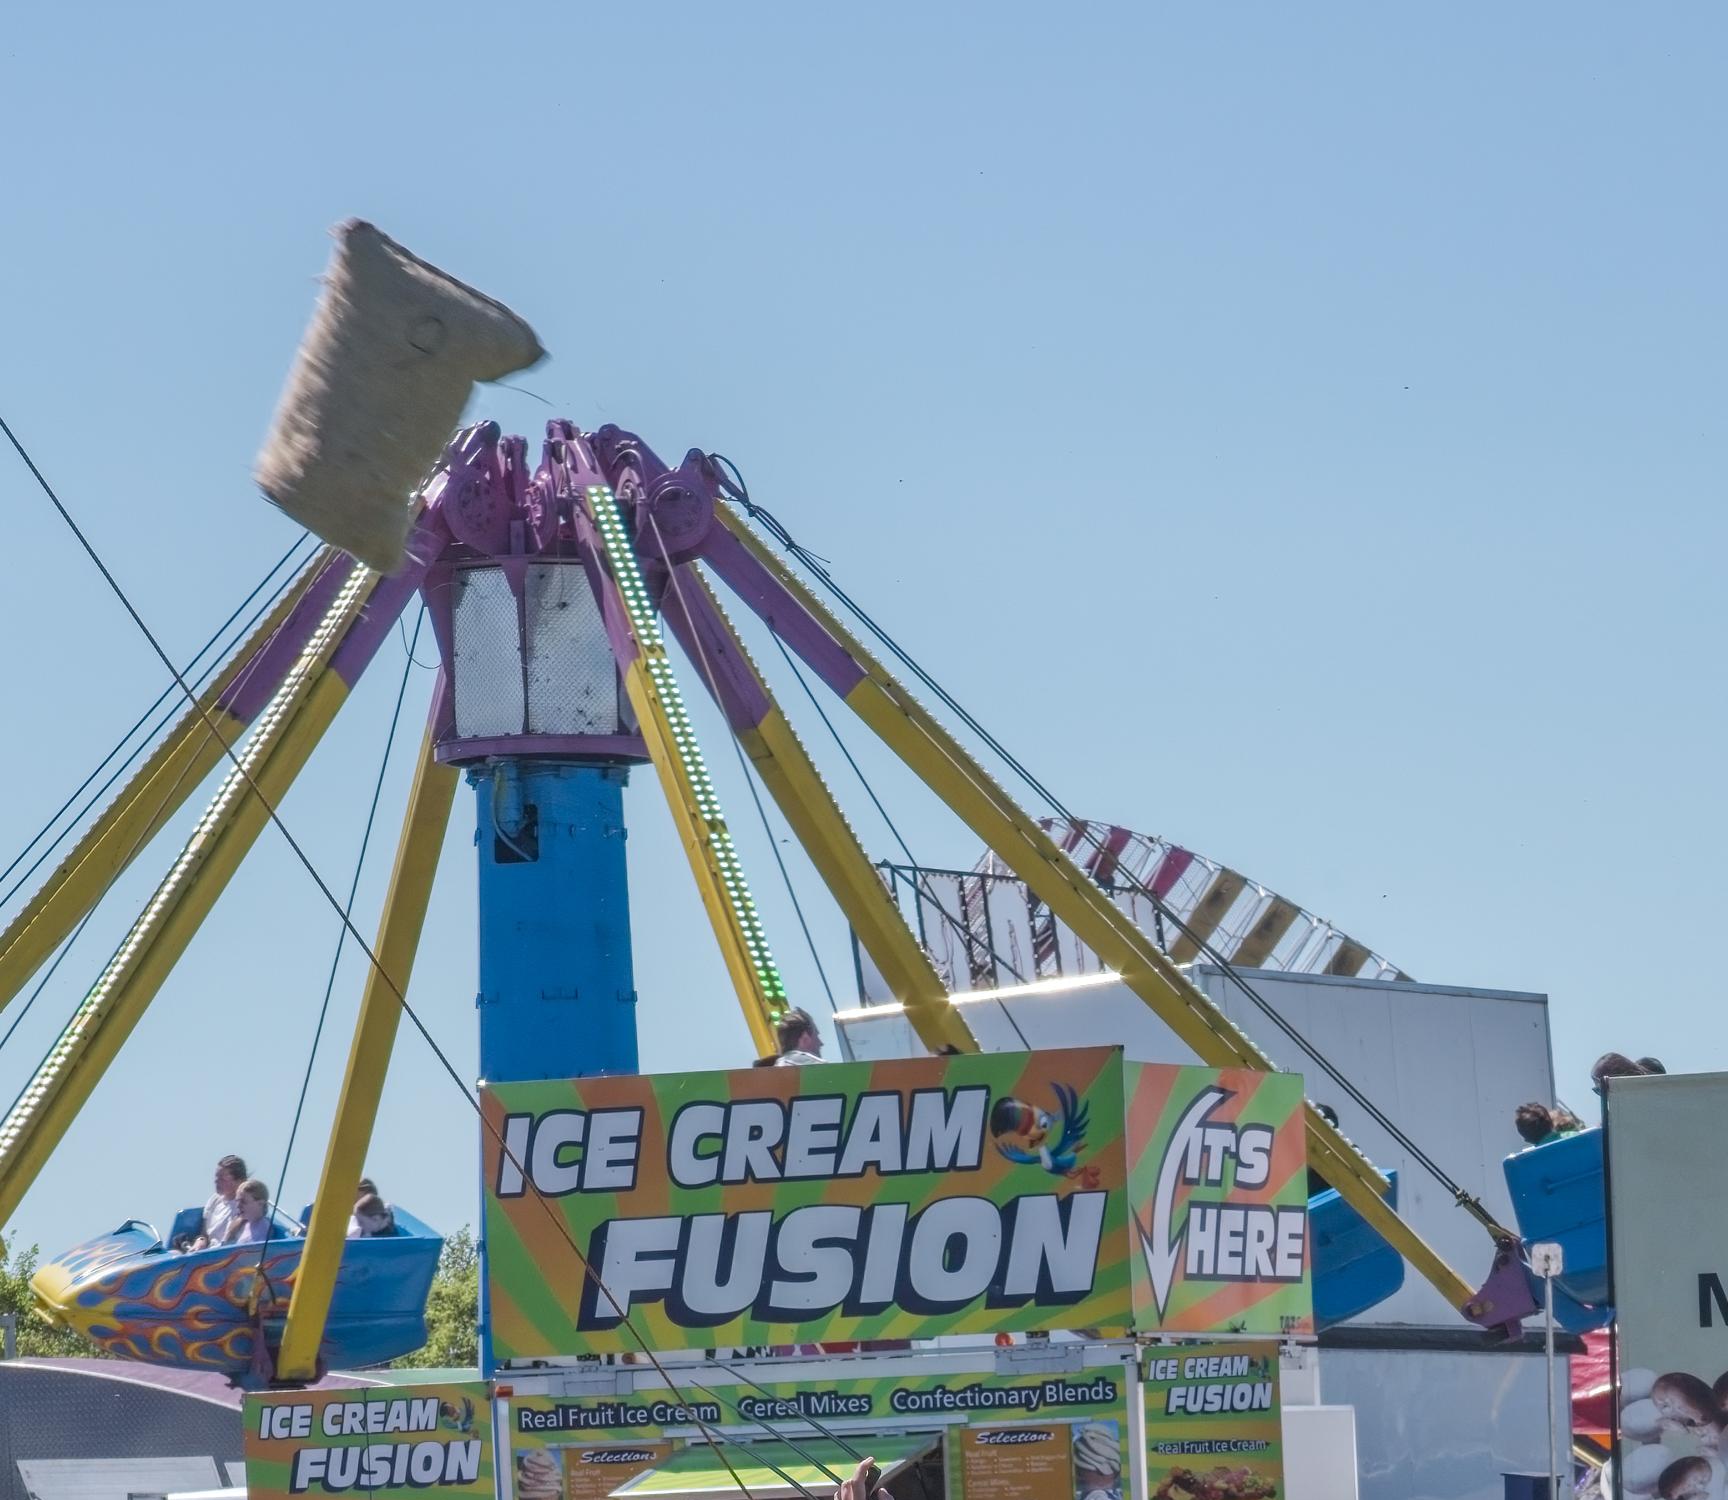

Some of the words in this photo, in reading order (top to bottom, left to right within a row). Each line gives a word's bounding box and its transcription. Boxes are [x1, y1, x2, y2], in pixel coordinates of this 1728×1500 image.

[498, 1107, 643, 1197] ICE
[668, 1085, 990, 1190] CREAM
[1185, 1126, 1274, 1187] IT'S
[1186, 1206, 1305, 1278] HERE
[583, 1191, 1108, 1327] FUSION
[1149, 1359, 1179, 1381] ICE
[1184, 1355, 1249, 1379] CREAM
[739, 1397, 804, 1418] Cereal
[810, 1394, 870, 1414] Mixes
[892, 1386, 1040, 1411] Confectionary
[1045, 1381, 1114, 1401] Blends
[1166, 1383, 1273, 1415] FUSION
[259, 1404, 313, 1440] ICE
[322, 1398, 440, 1437] CREAM
[521, 1409, 563, 1429] Real
[568, 1407, 616, 1427] Fruit
[620, 1405, 648, 1424] Ice
[652, 1402, 719, 1423] Cream
[974, 1430, 1056, 1445] Selections
[1158, 1442, 1182, 1454] Real
[1184, 1440, 1210, 1453] Fruit
[1212, 1440, 1228, 1451] Ice
[1229, 1438, 1266, 1451] Cream
[291, 1440, 482, 1492] FUSION
[579, 1450, 657, 1464] Selections
